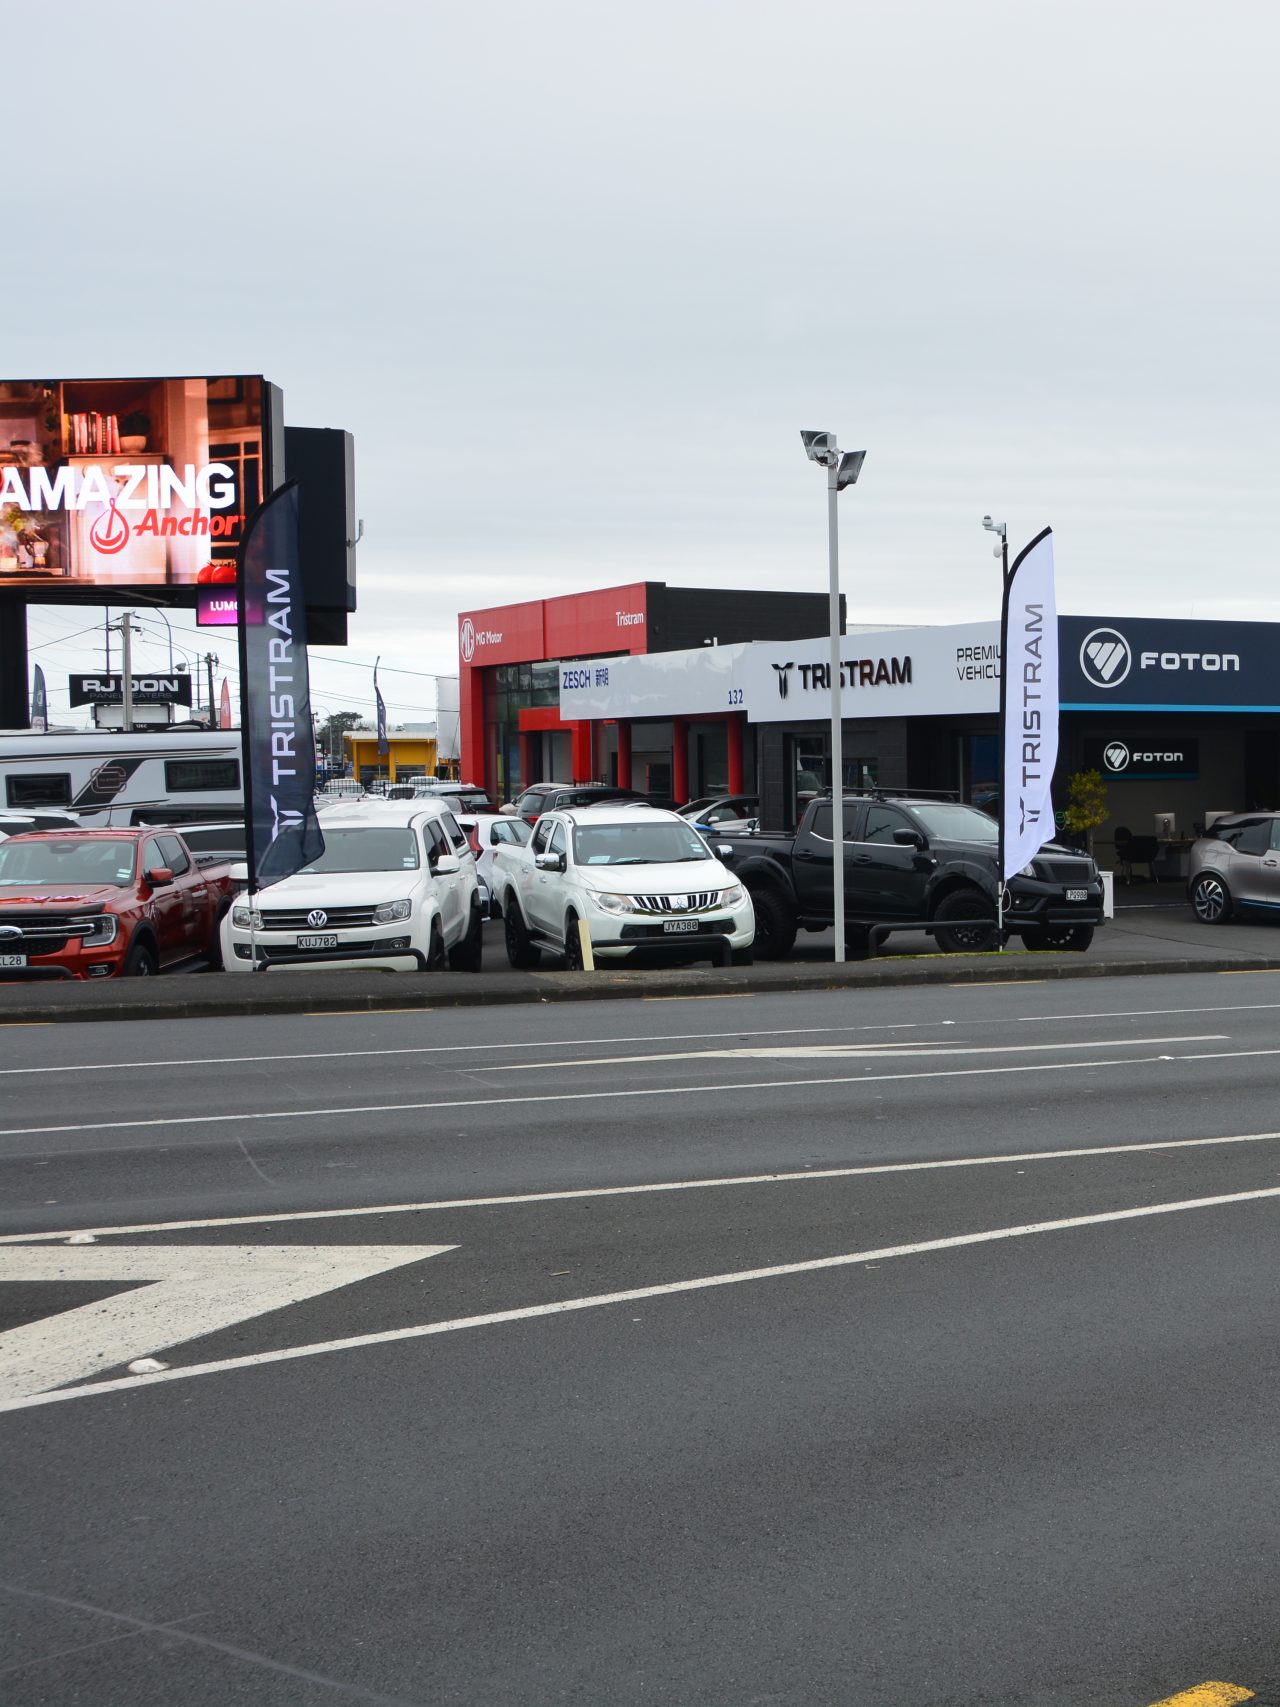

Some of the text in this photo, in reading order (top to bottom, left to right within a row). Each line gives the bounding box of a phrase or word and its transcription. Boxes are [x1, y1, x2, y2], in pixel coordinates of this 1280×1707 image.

[0, 463, 236, 511] AMAZING
[132, 508, 239, 537] Anchor
[210, 600, 238, 611] LUM
[616, 612, 644, 627] Tristram
[476, 630, 503, 646] MG Motor
[956, 644, 1001, 662] PREMIU
[1140, 651, 1240, 672] FOTON
[266, 569, 296, 786] TRISTRAM
[562, 670, 591, 690] ZESCH
[956, 663, 1001, 681] VEHICL
[82, 679, 116, 692] RJ
[727, 689, 744, 705] 132
[1022, 603, 1043, 787] TRISTRAM
[1133, 752, 1183, 762] FOTON
[298, 936, 336, 948] KUJ702
[0, 955, 22, 967] L28
